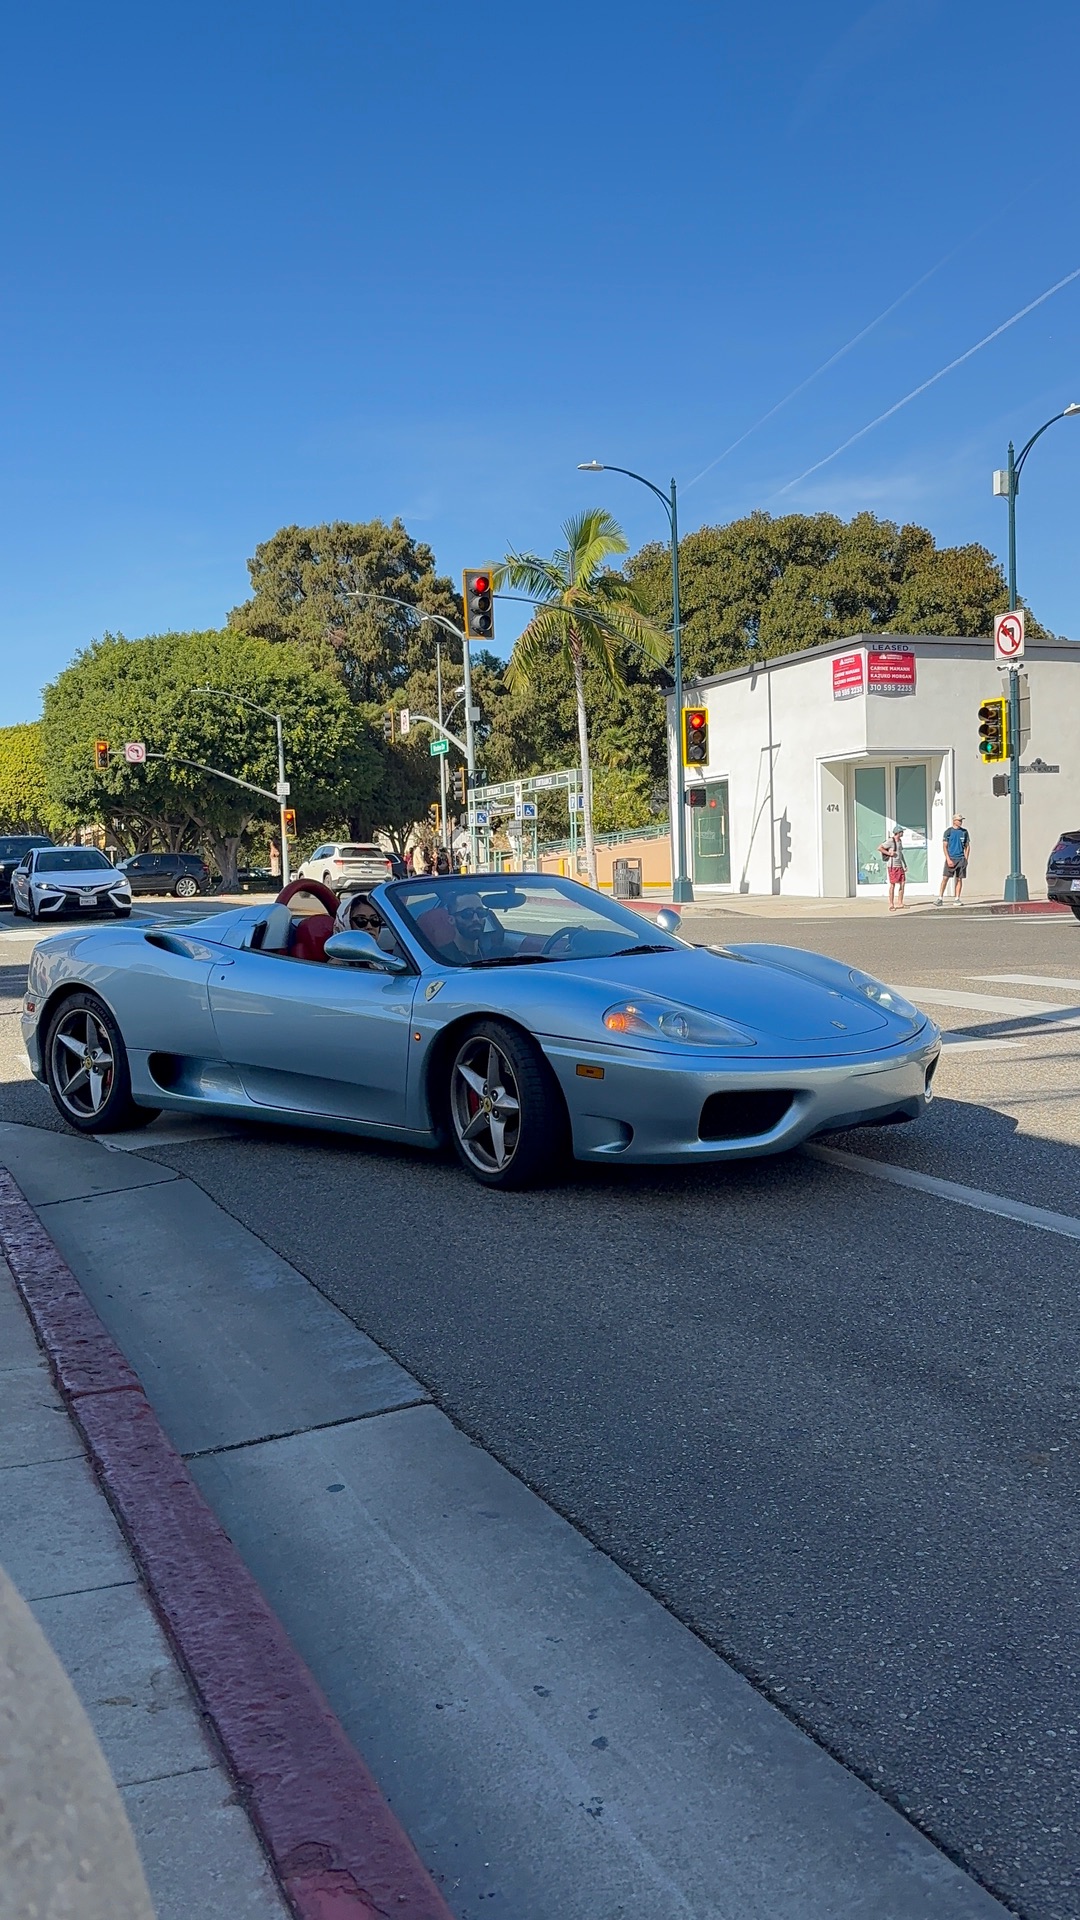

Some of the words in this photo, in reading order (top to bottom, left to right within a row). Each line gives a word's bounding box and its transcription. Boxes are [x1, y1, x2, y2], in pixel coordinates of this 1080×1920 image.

[935, 799, 944, 807] 474
[827, 804, 840, 812] 474
[864, 862, 880, 872] 474
